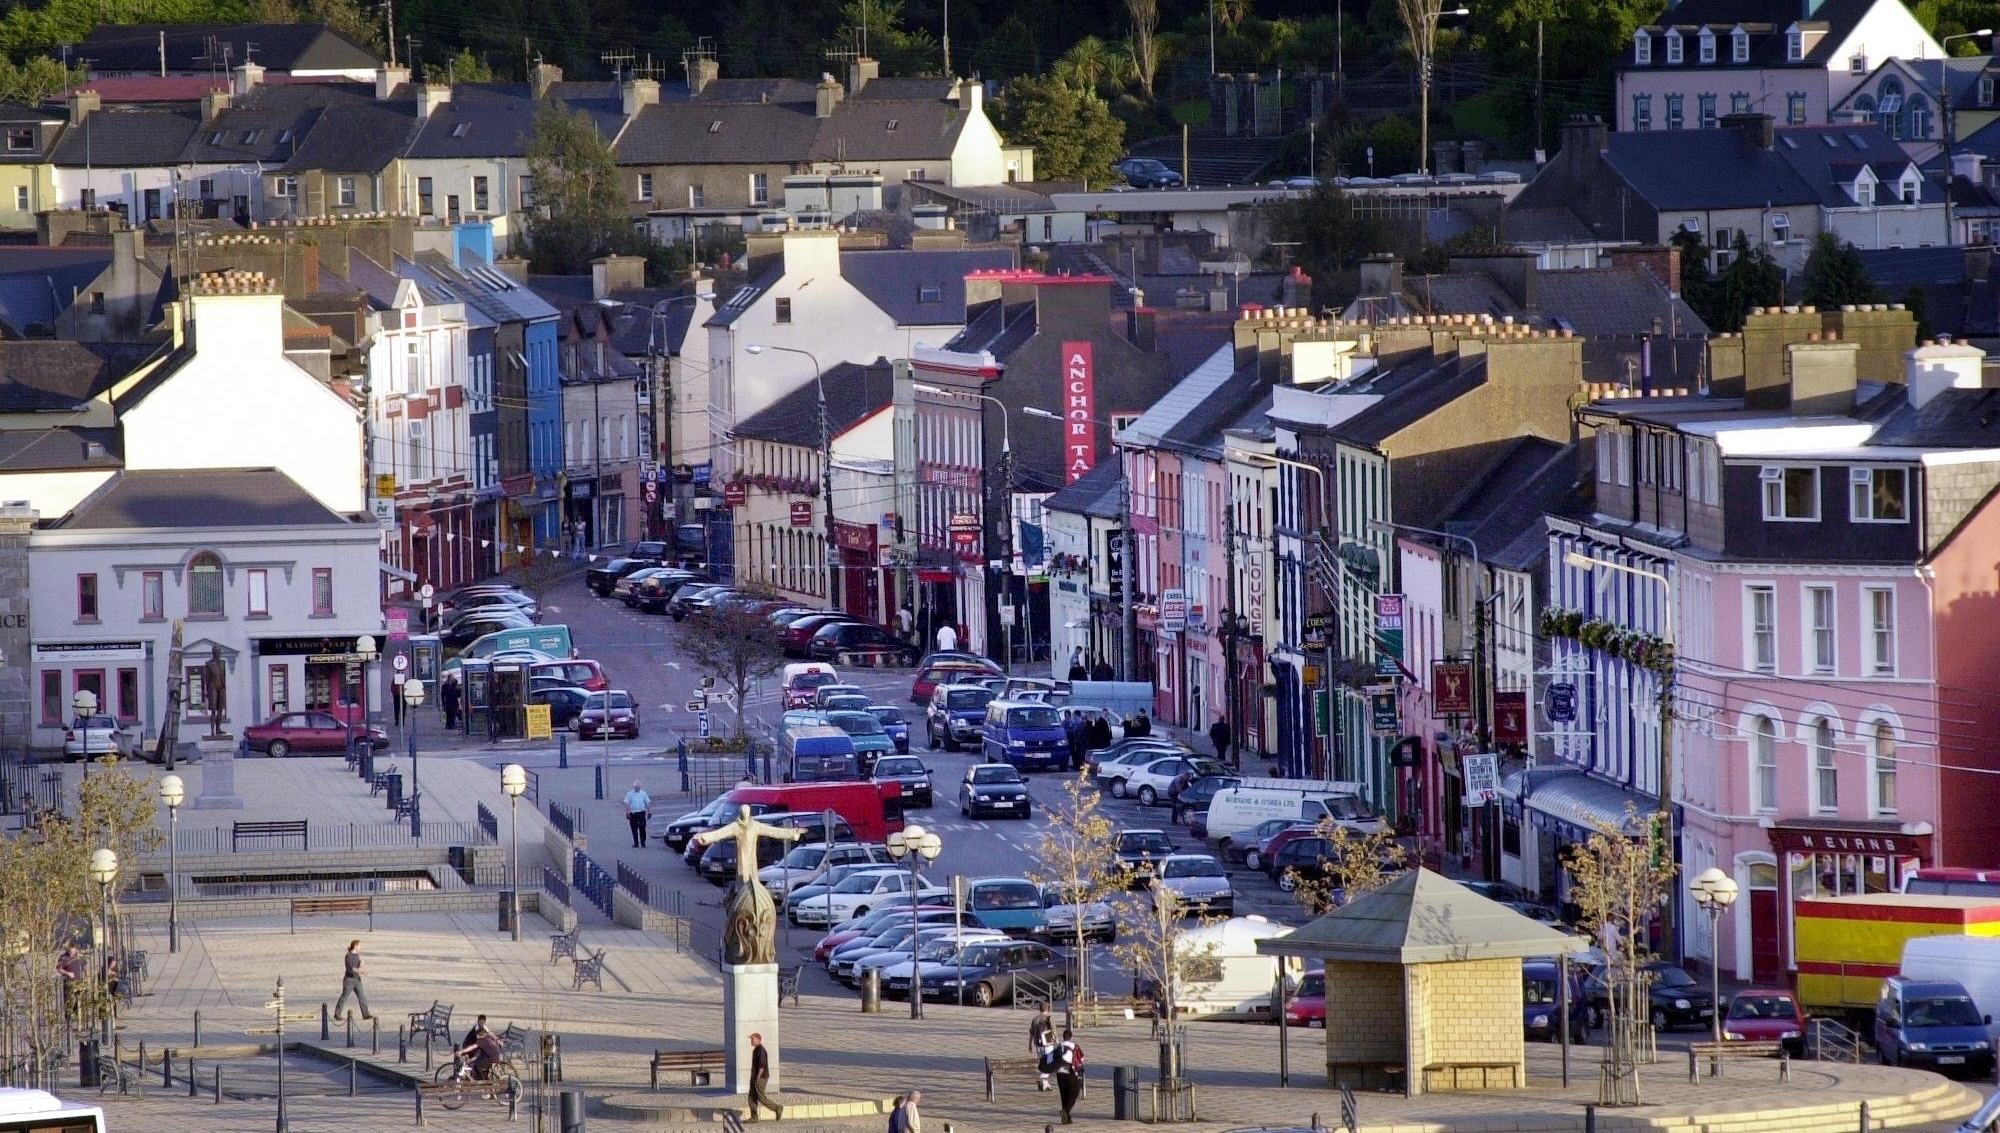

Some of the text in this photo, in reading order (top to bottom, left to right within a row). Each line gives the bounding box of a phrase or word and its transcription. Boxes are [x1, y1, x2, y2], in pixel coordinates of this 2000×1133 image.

[1070, 354, 1088, 435] ANCHOR
[1251, 555, 1261, 634] LOUNGE
[1381, 618, 1400, 627] AIB
[701, 720, 708, 737] P
[1479, 790, 1495, 800] YES
[1802, 835, 1895, 851] M EVANS
